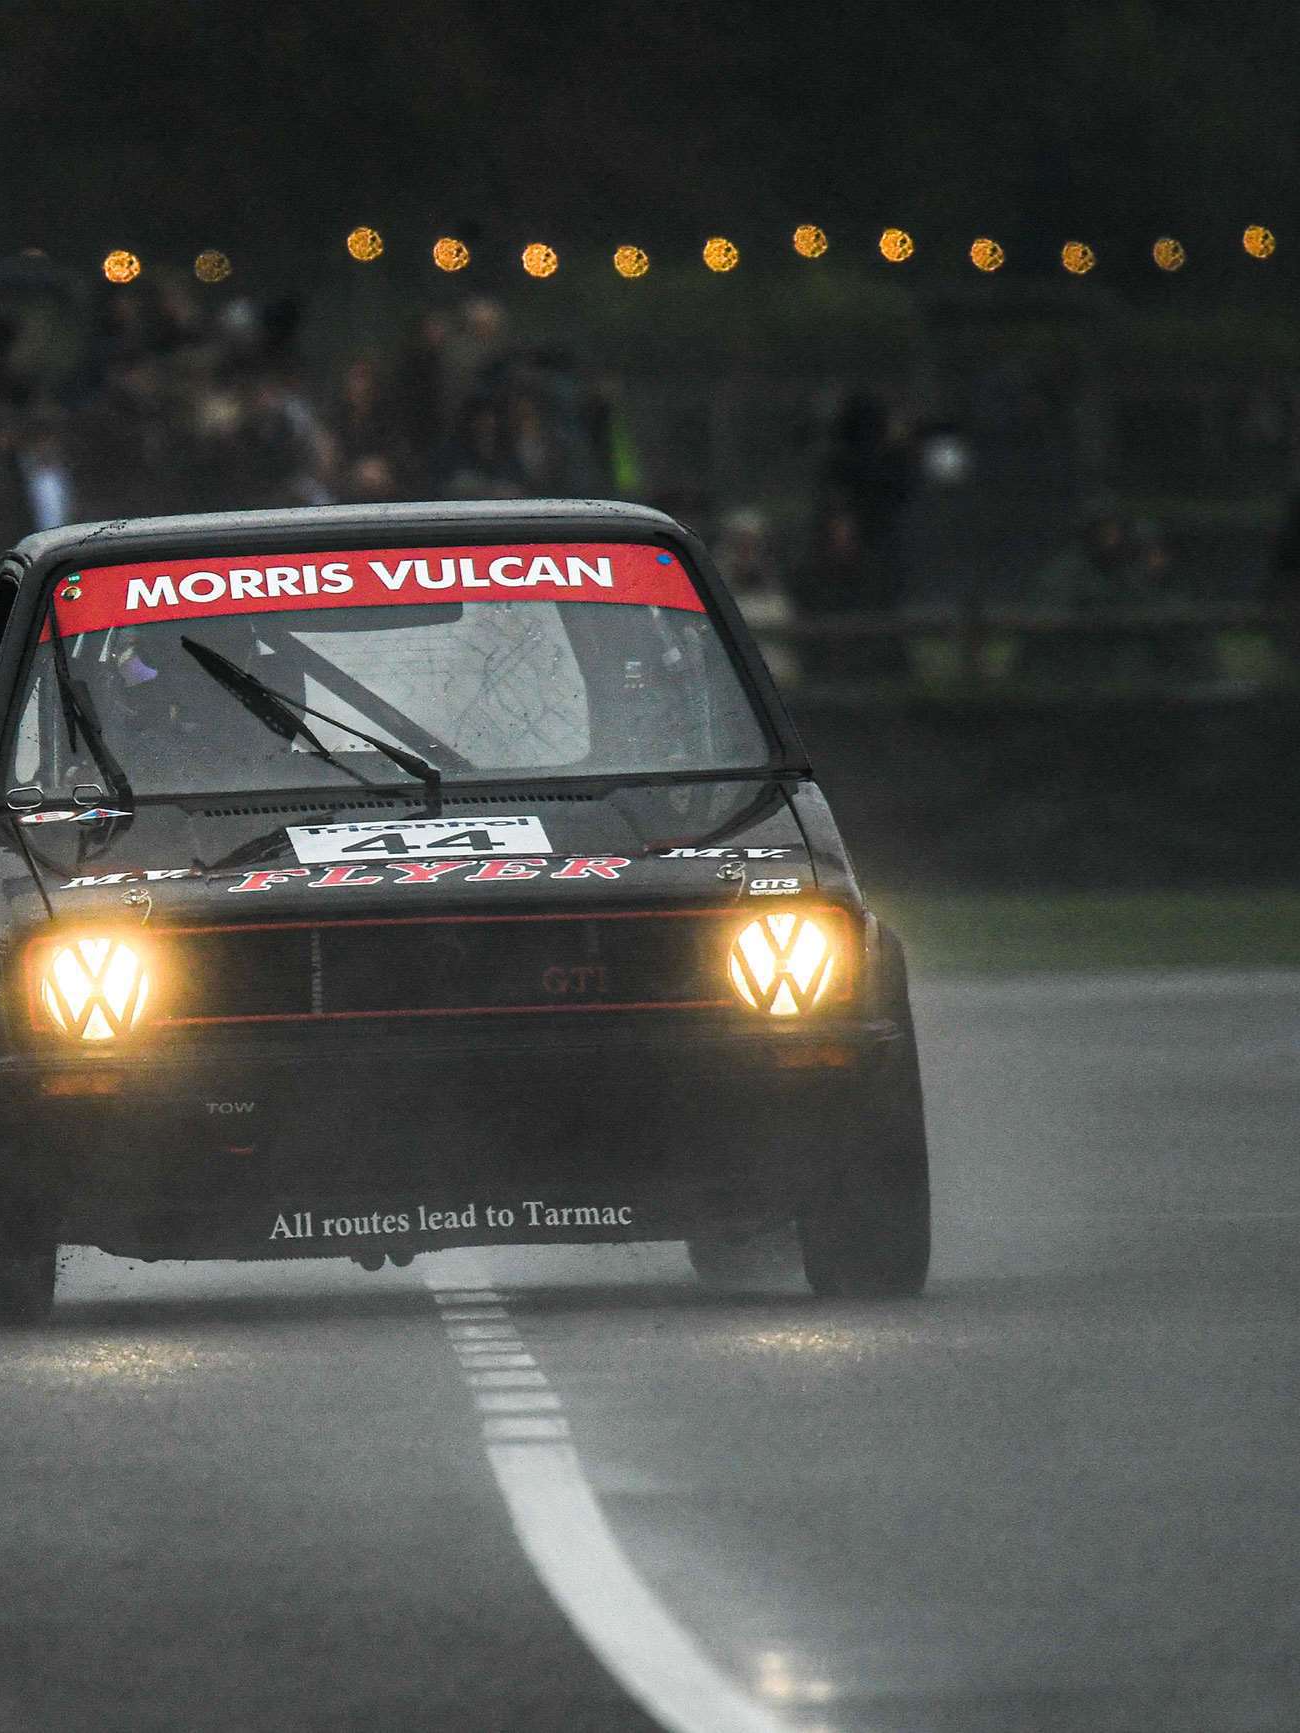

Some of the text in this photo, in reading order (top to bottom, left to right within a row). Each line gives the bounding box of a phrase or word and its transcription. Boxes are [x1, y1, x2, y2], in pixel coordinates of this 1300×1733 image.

[125, 556, 614, 610] MORRIS VULCAN
[341, 830, 505, 855] 44
[227, 857, 632, 893] FLYER
[750, 878, 799, 889] GTS
[205, 1101, 254, 1114] TOW
[268, 1200, 633, 1240] All routes lead to Tarmac
